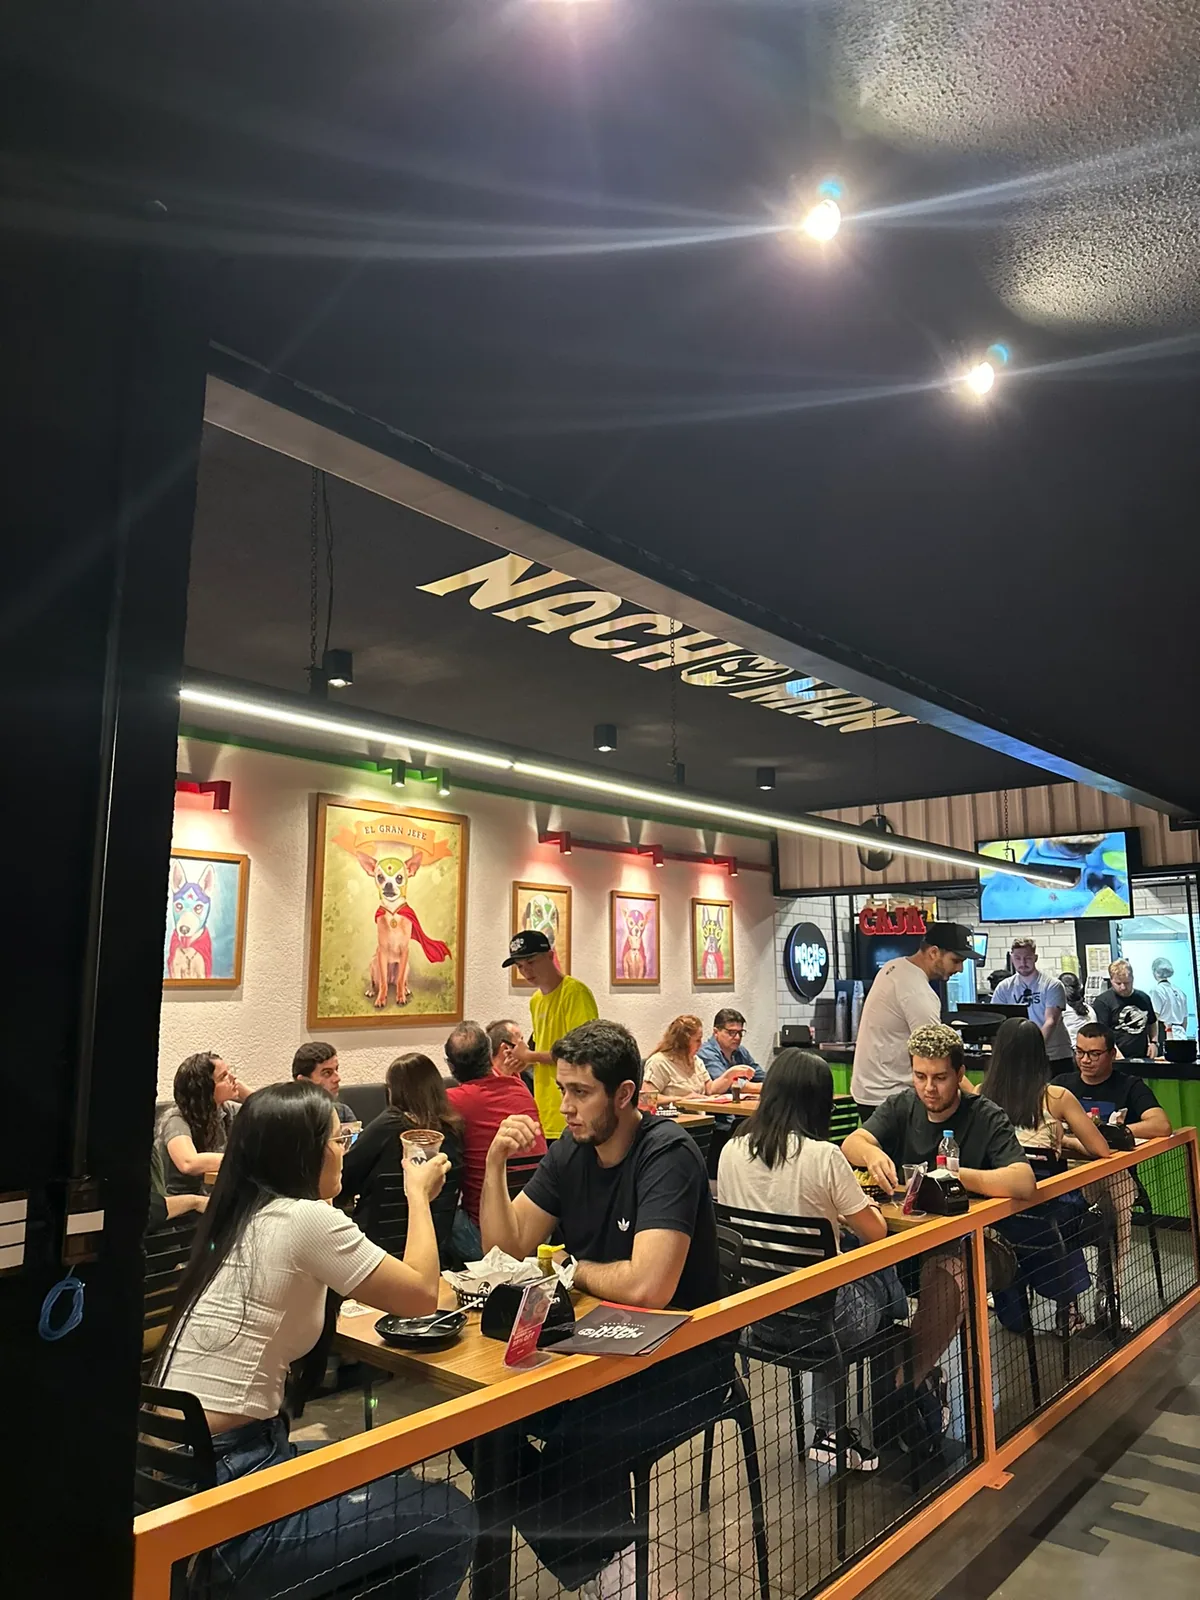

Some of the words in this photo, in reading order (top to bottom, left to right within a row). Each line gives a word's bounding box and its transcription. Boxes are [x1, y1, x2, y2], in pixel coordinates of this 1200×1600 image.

[365, 825, 375, 834] EL
[378, 824, 404, 835] GRAN
[407, 829, 426, 840] JEFE
[859, 906, 927, 935] CAJA
